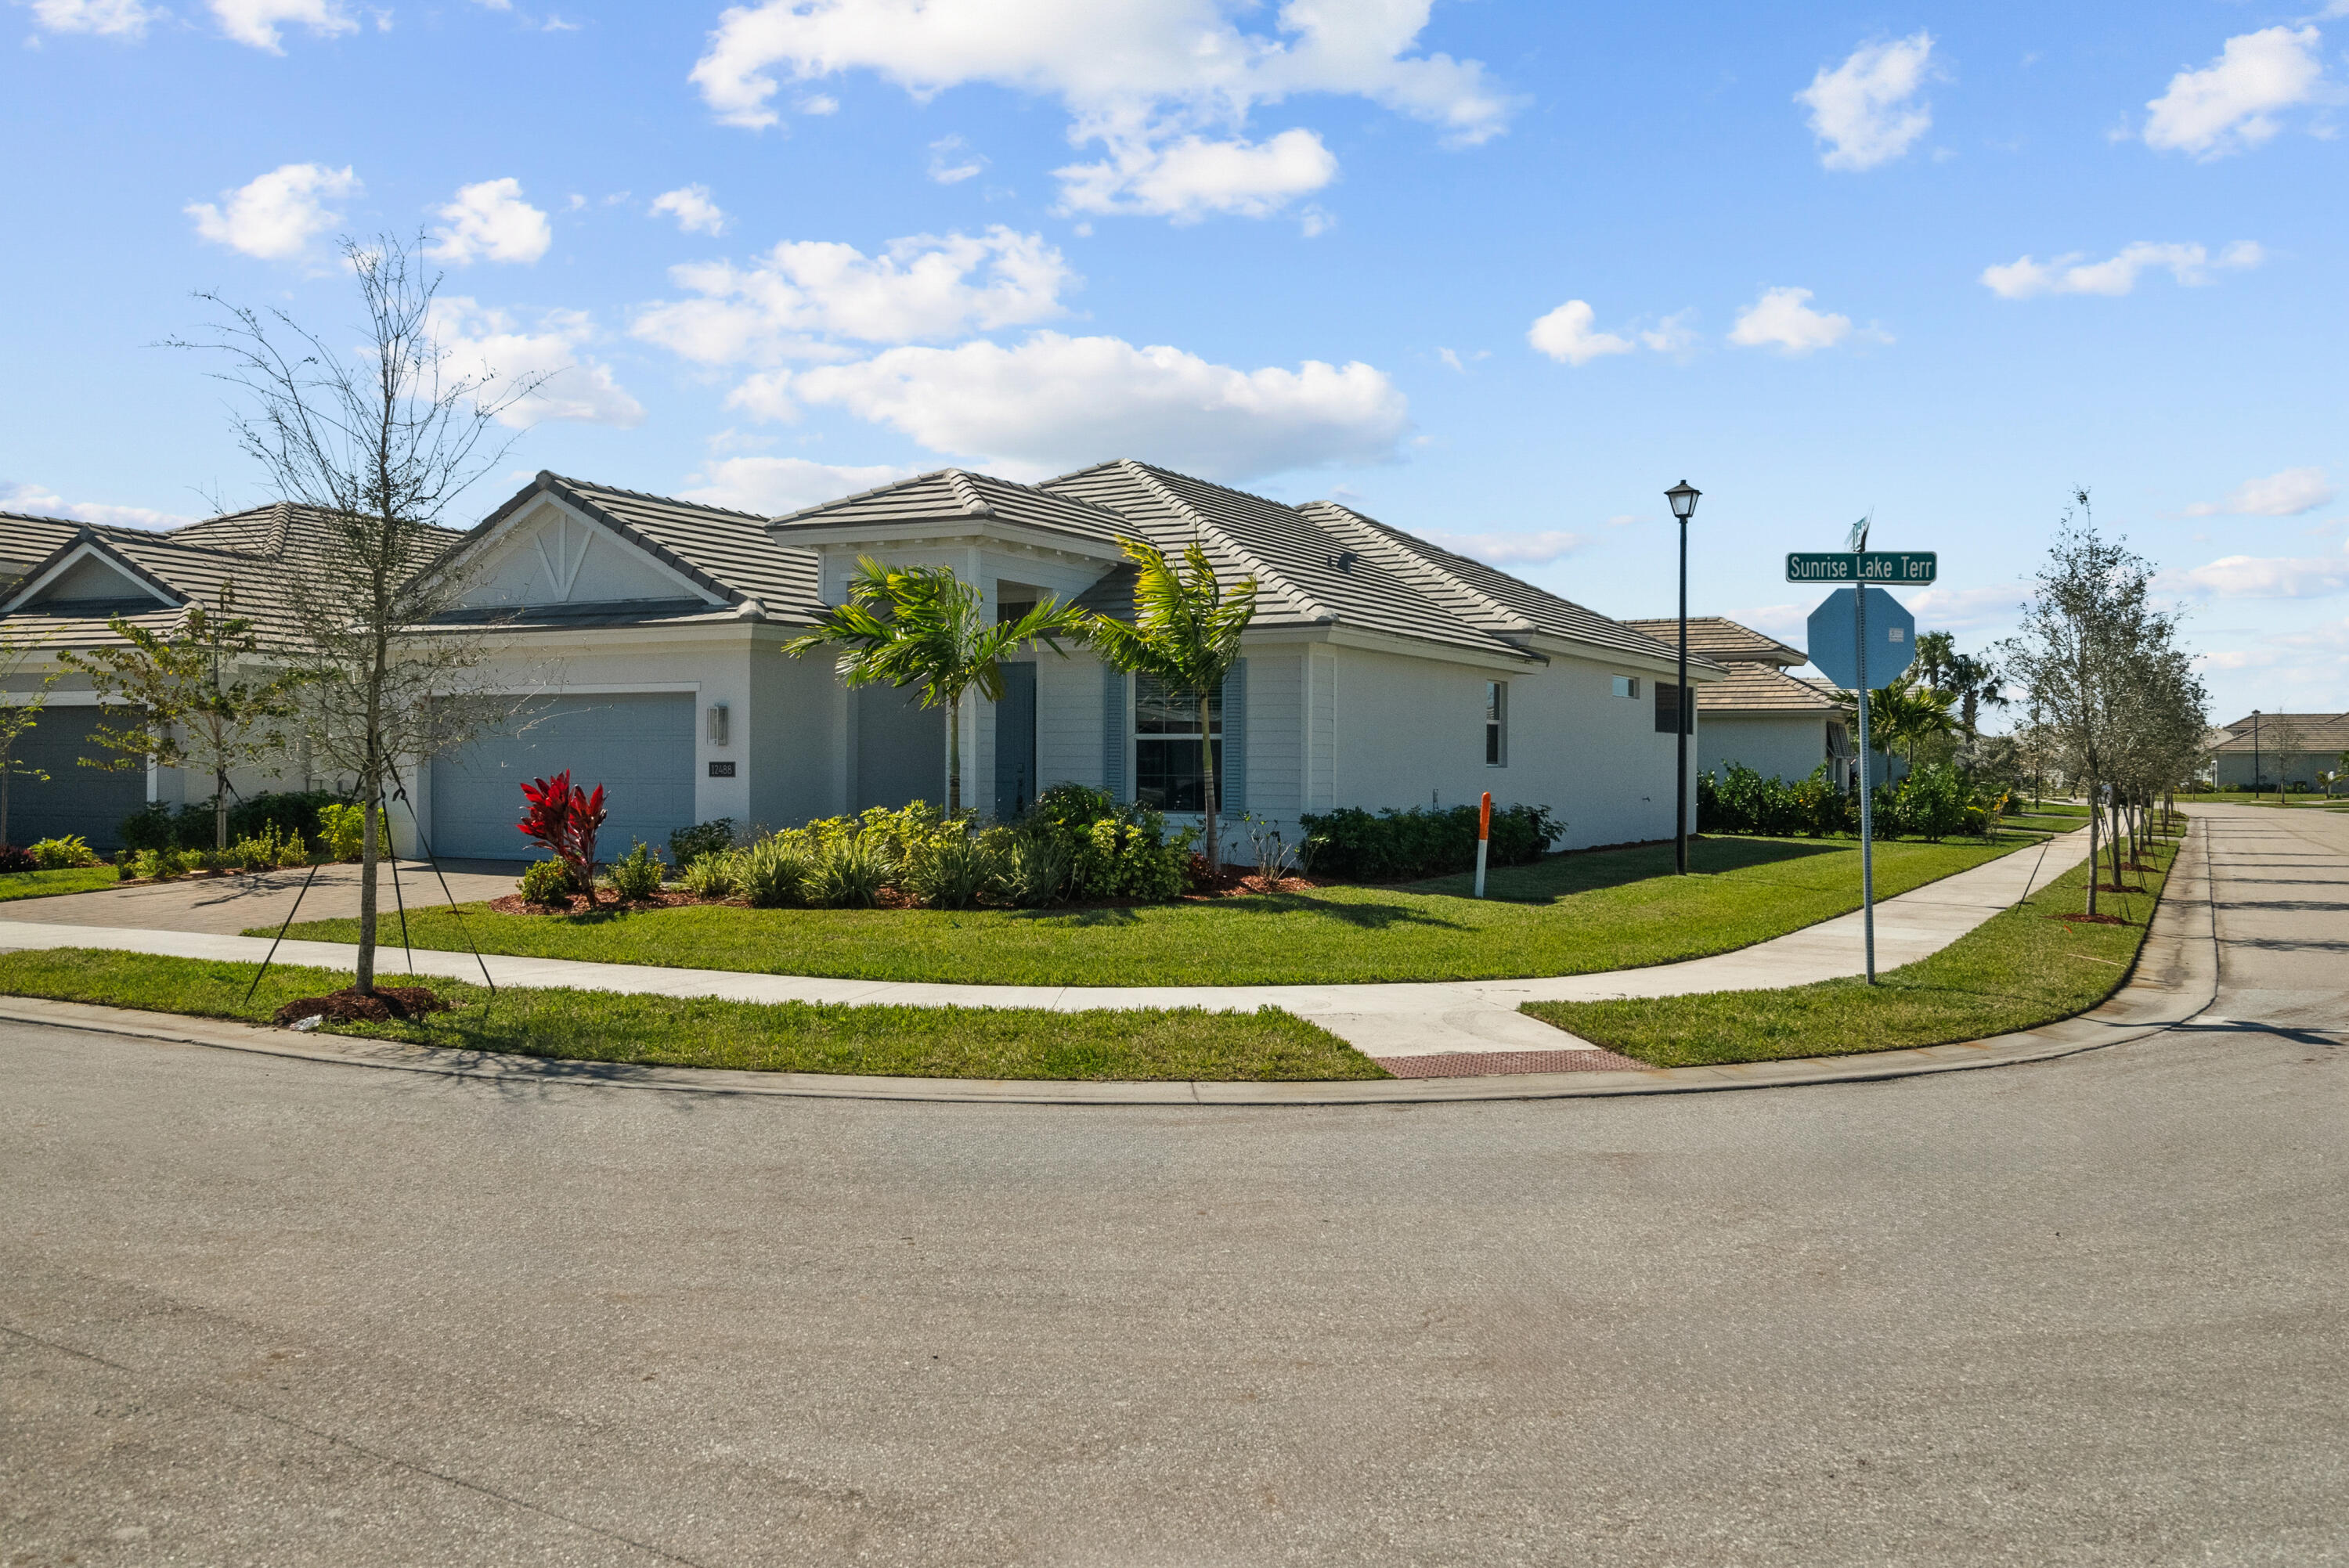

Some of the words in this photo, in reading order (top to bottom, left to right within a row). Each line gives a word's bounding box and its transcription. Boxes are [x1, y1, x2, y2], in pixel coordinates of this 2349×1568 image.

[1791, 556, 1847, 577] Sunrise
[1856, 556, 1893, 578] Lake
[1901, 556, 1932, 578] Terr
[711, 764, 733, 775] 12488
